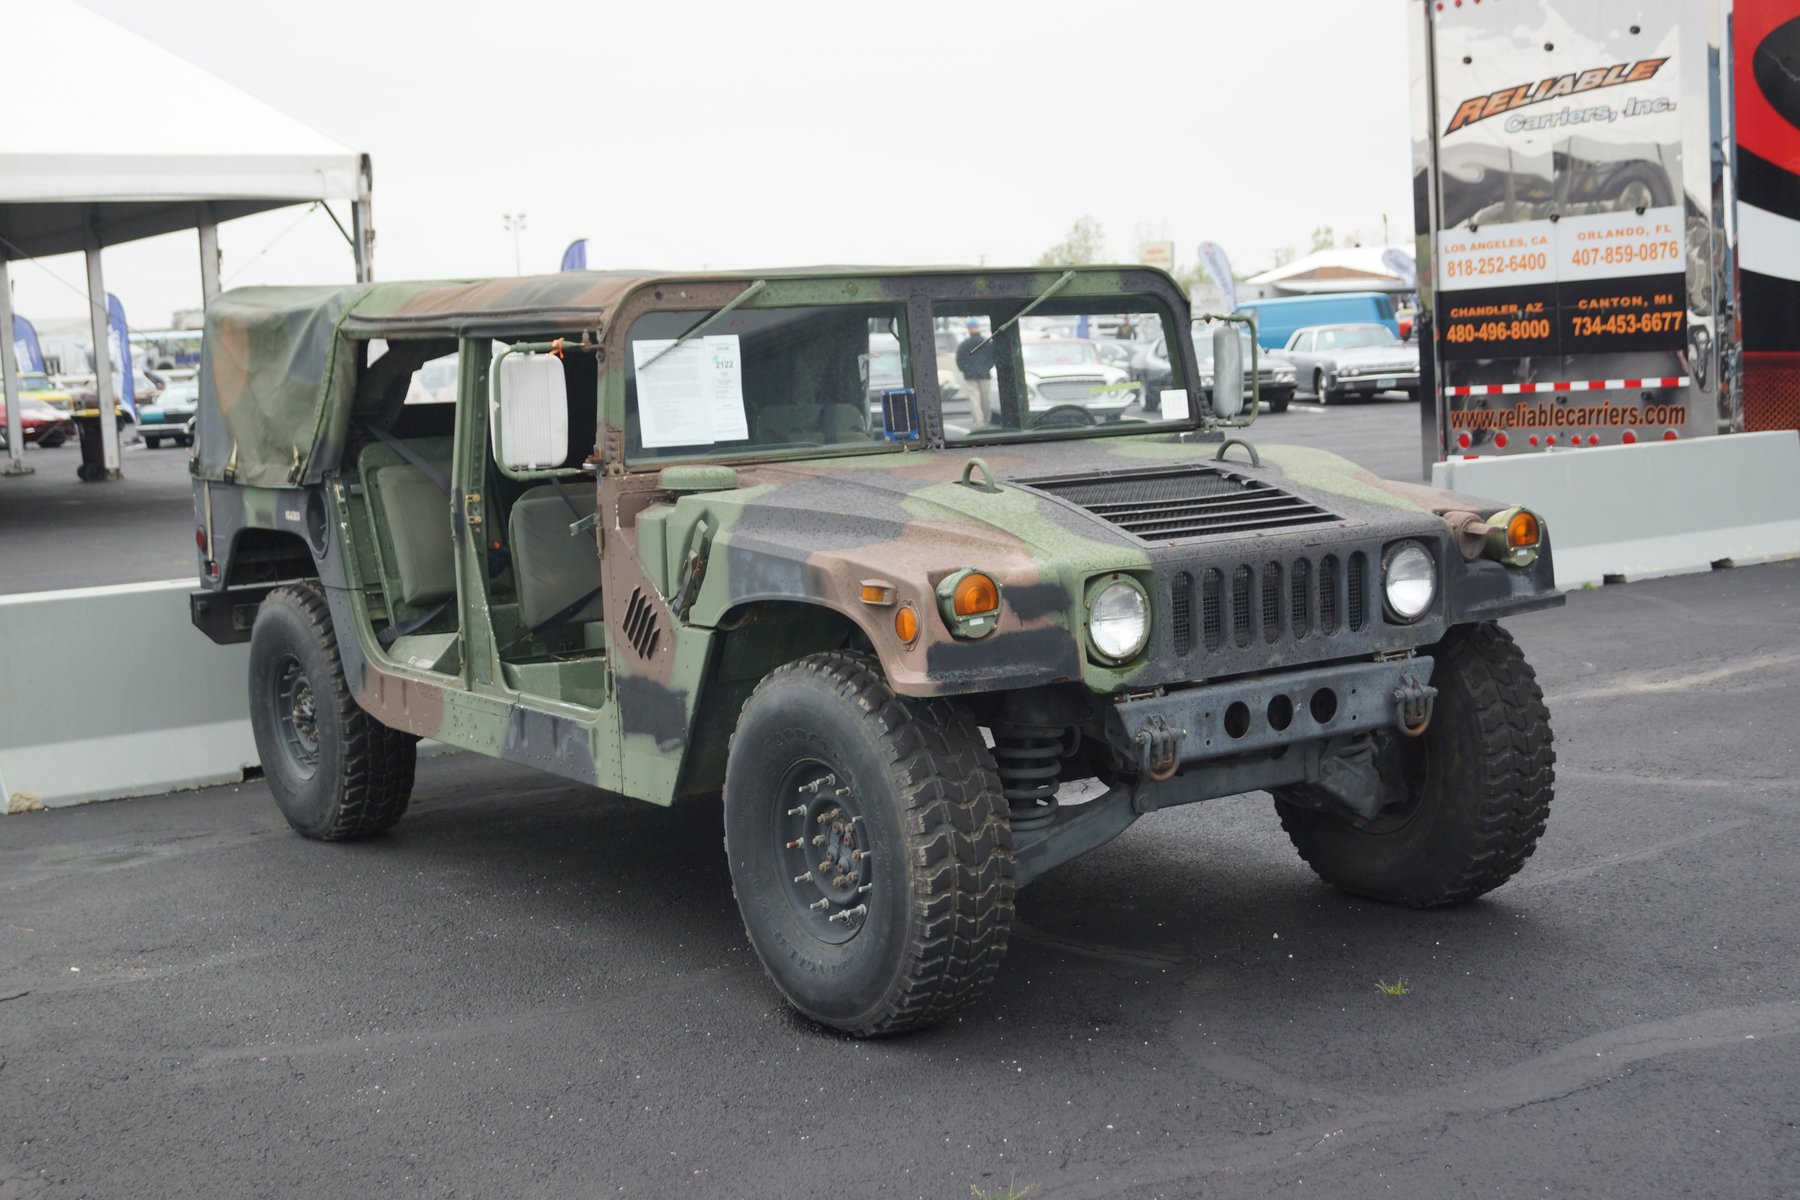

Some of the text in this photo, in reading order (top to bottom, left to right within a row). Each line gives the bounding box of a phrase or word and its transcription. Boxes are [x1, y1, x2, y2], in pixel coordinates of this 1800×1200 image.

[1443, 57, 1670, 138] RELIABLE
[1504, 97, 1677, 133] Carriers, Inc.
[1577, 224, 1672, 241] ORLANDO, FL
[1444, 236, 1548, 254] LOS ANGELES, CA
[1572, 240, 1679, 266] 407-859-0876
[1447, 252, 1546, 277] 818-252-6400
[1525, 302, 1544, 313] AZ
[1577, 294, 1673, 311] CANTON, MI
[1446, 319, 1550, 343] 480-496-8000
[1572, 310, 1683, 336] 734-453-6677
[715, 361, 734, 369] 2122
[1450, 401, 1687, 430] www.reliablecarriers.com
